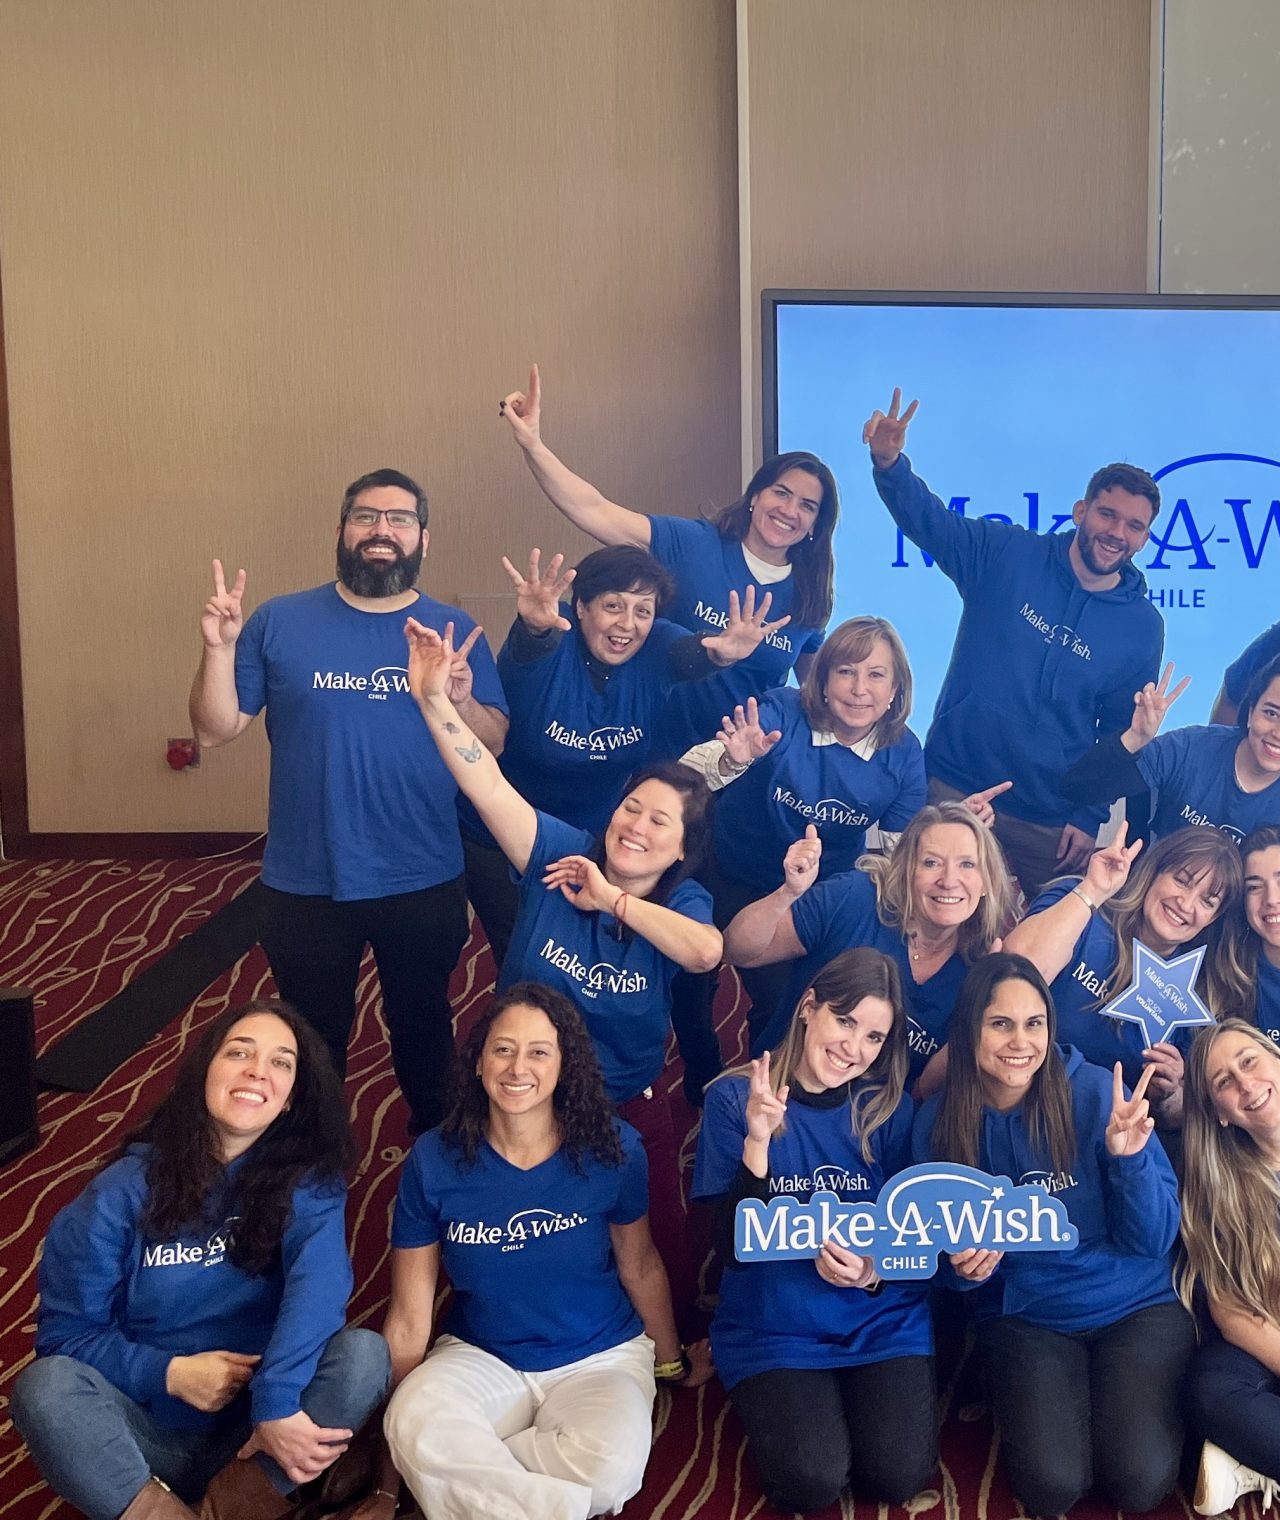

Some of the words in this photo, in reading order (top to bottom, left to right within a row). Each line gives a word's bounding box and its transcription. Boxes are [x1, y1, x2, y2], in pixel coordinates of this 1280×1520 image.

[1149, 589, 1206, 608] HILE
[581, 987, 598, 999] CHILE
[502, 1244, 525, 1253] CHILE
[205, 1255, 224, 1267] CHILE
[882, 1256, 928, 1270] CHILE
